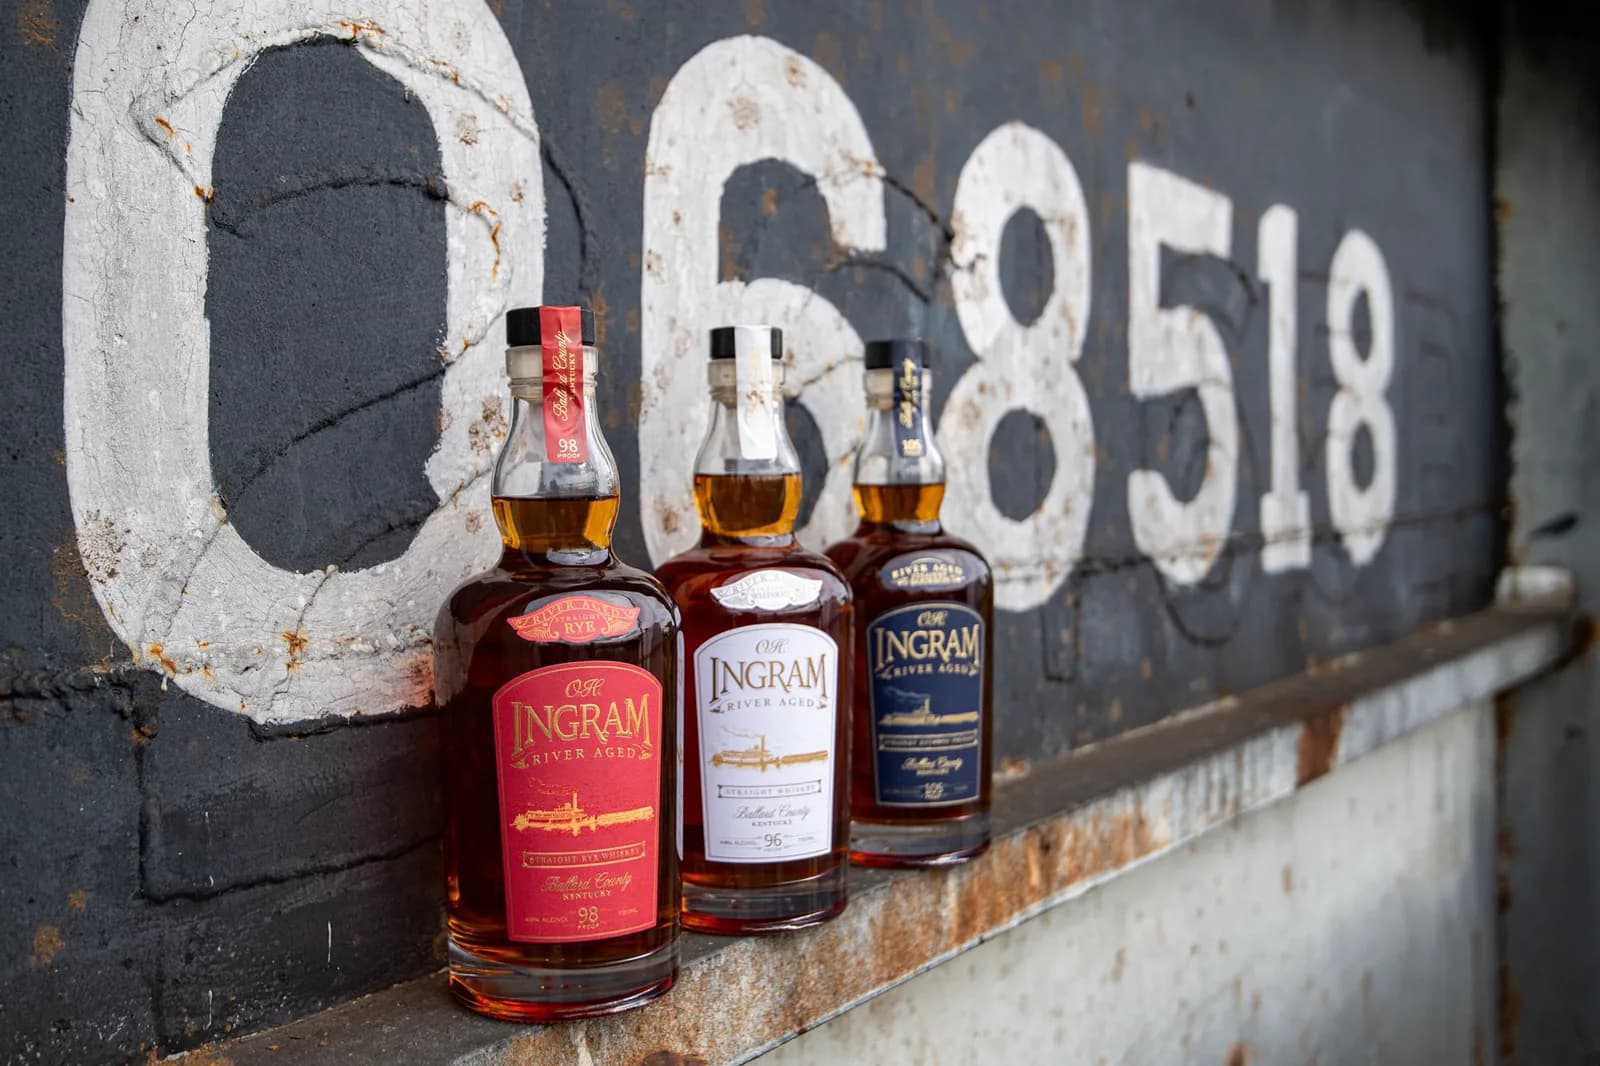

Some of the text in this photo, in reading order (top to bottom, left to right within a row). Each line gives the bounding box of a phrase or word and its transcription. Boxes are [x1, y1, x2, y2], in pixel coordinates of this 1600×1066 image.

[552, 330, 573, 371] County
[558, 438, 578, 453] 98
[891, 564, 929, 579] RIVER
[533, 600, 621, 625] RIVER AGED
[564, 621, 597, 634] RYE
[875, 624, 980, 669] INGRAM
[710, 653, 828, 703] INGRAM
[893, 663, 970, 677] RIVER AGED
[727, 697, 815, 711] RIVER AGED
[511, 693, 653, 754] INGRAM
[532, 747, 636, 765] RIVER AGED
[723, 788, 773, 796] STRAIGHT
[764, 833, 783, 848] 96
[528, 847, 640, 865] STRAIGHT RYE WHISKEY
[541, 871, 633, 892] Ballard County
[562, 889, 612, 901] KENTUCKY
[578, 906, 599, 923] 98
